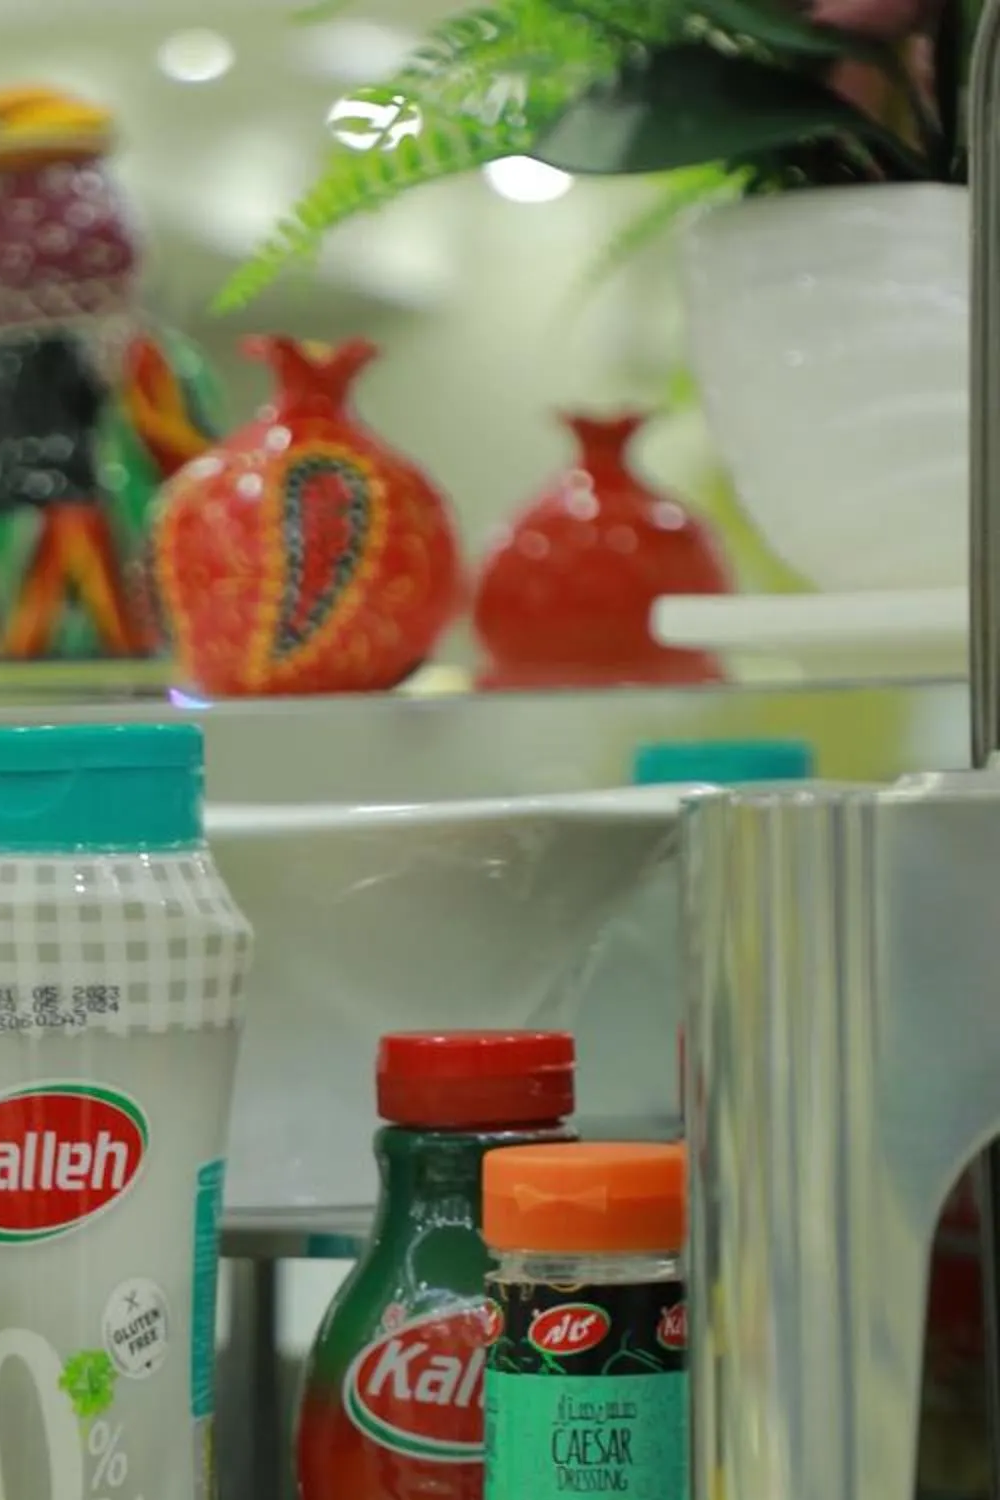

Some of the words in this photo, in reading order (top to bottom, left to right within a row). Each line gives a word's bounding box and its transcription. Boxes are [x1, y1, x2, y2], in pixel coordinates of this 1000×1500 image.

[113, 1308, 160, 1345] GLUTEN
[128, 1326, 158, 1356] FREE
[552, 1427, 633, 1465] CAESAR
[556, 1466, 628, 1492] DRESSING
